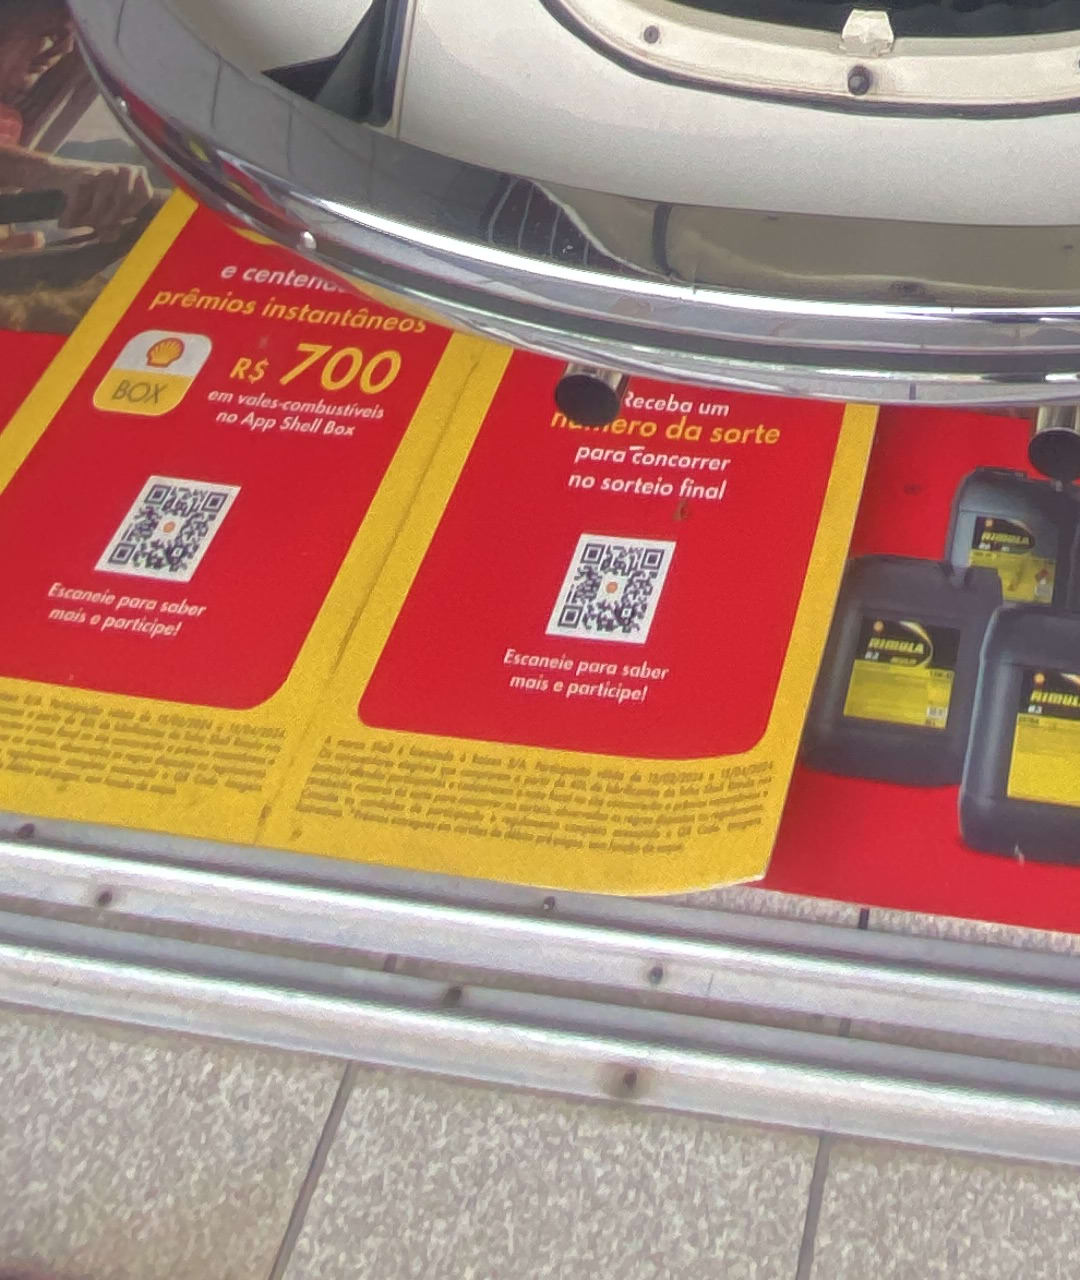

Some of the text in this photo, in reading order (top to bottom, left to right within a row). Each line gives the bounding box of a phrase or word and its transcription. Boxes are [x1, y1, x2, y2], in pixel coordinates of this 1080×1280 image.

[220, 264, 350, 293] e centen
[148, 288, 428, 334] prêmios instantâneos
[230, 342, 402, 395] R$ 700
[112, 379, 166, 405] BOX
[208, 389, 385, 419] em vales-combustíveis
[216, 410, 355, 436] no App Shell Box
[698, 401, 730, 416] um
[550, 413, 781, 445] nero da sorte
[574, 445, 731, 472] para concorrer
[568, 472, 728, 500] no sorteio final
[48, 582, 206, 618] Escaneie para saber
[49, 606, 86, 624] mais
[99, 613, 182, 639] participe!
[503, 648, 669, 680] Escaneie para saber
[509, 673, 648, 704] mais e participe!
